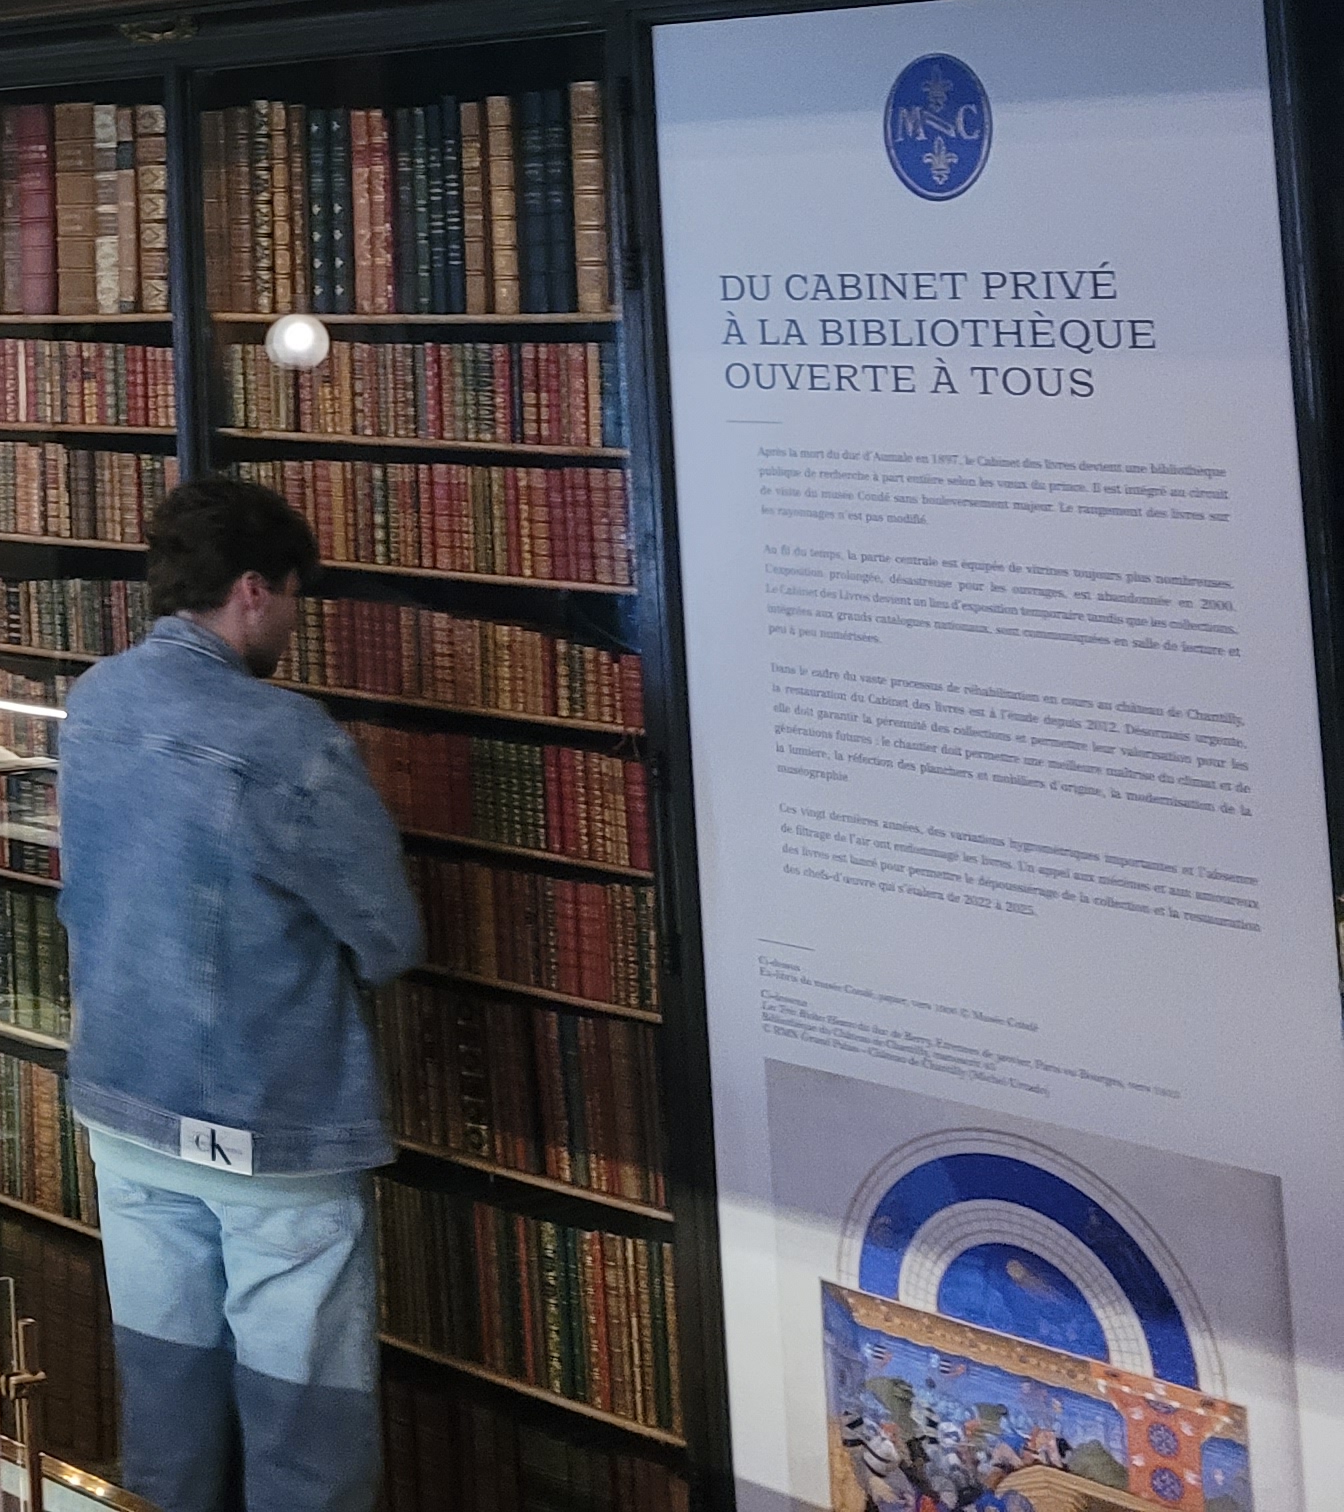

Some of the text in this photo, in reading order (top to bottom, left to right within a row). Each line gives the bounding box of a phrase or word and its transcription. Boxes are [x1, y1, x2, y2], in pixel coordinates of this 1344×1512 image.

[720, 262, 1116, 300] DU CABINET PRIVÉ
[722, 311, 1155, 354] À LA BIBLIOTHÈQUE
[726, 358, 1094, 397] OUVERTE À TOUS
